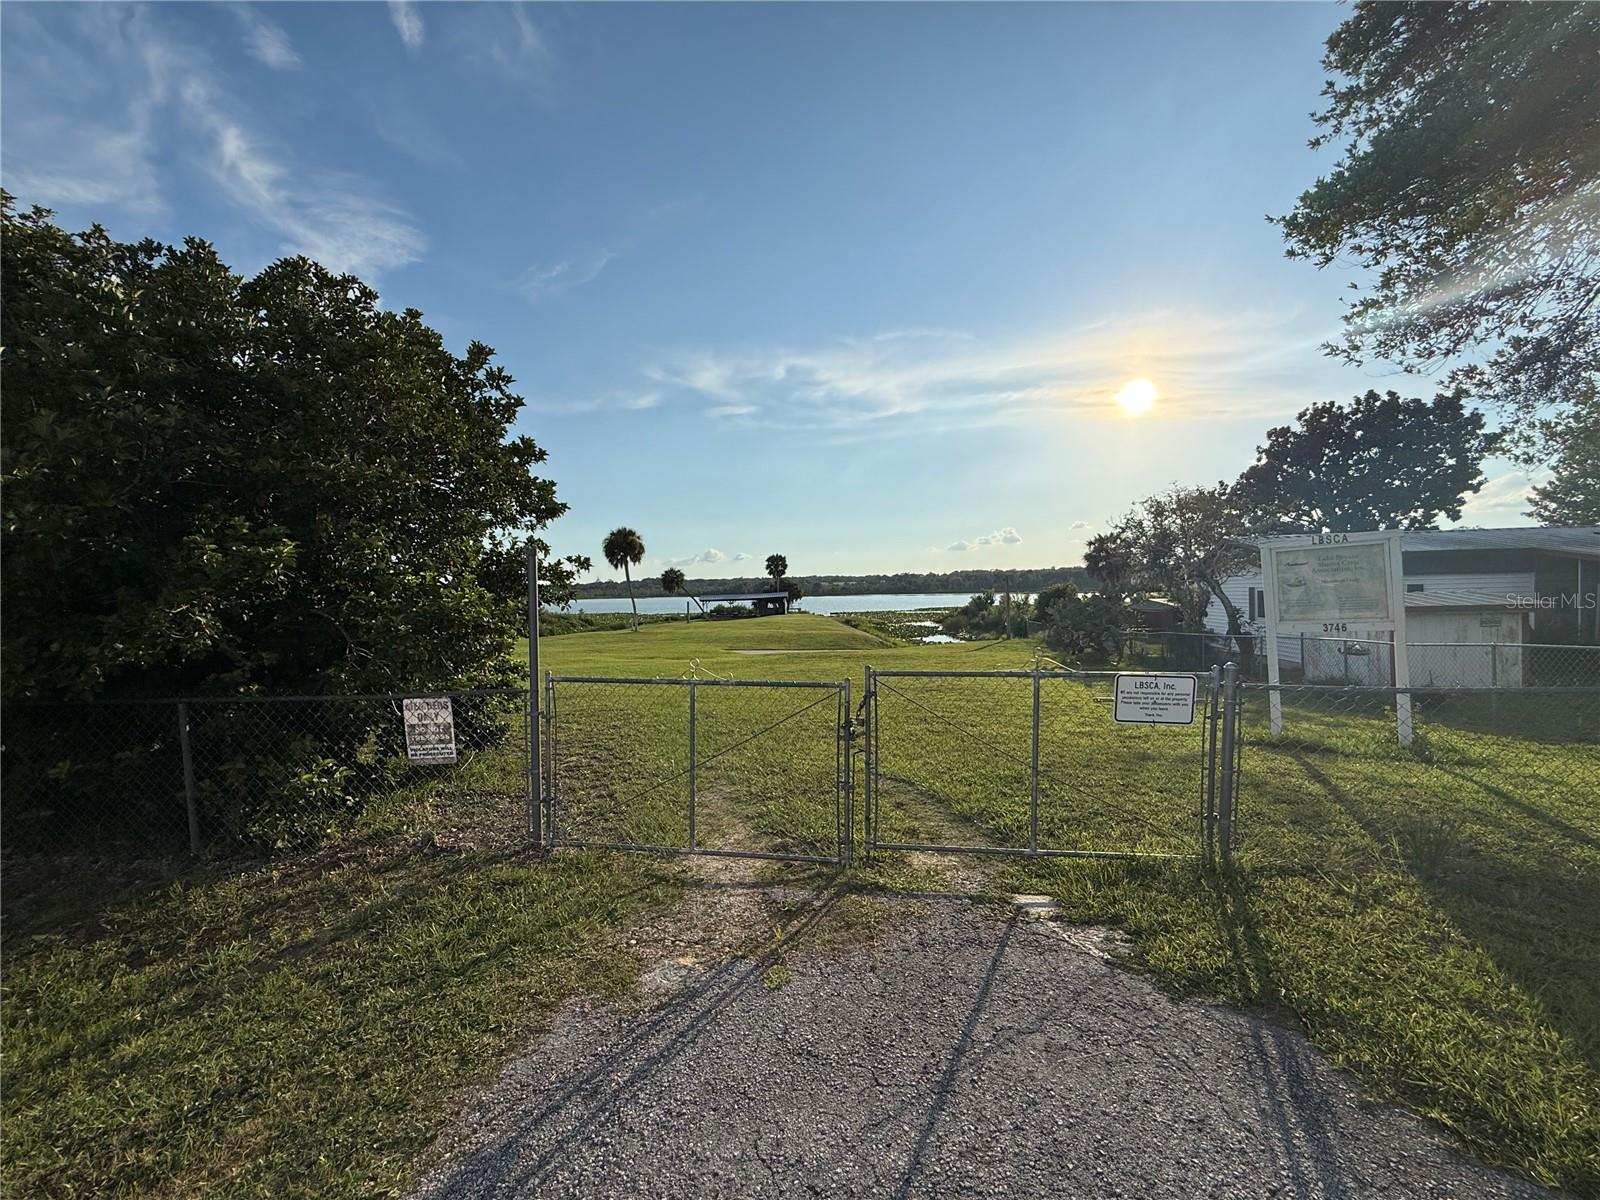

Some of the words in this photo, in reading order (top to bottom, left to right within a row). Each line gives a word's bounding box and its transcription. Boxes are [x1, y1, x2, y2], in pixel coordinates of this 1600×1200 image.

[1312, 534, 1348, 545] LBSCA
[1322, 623, 1348, 632] 3746
[1163, 682, 1177, 690] Inc.
